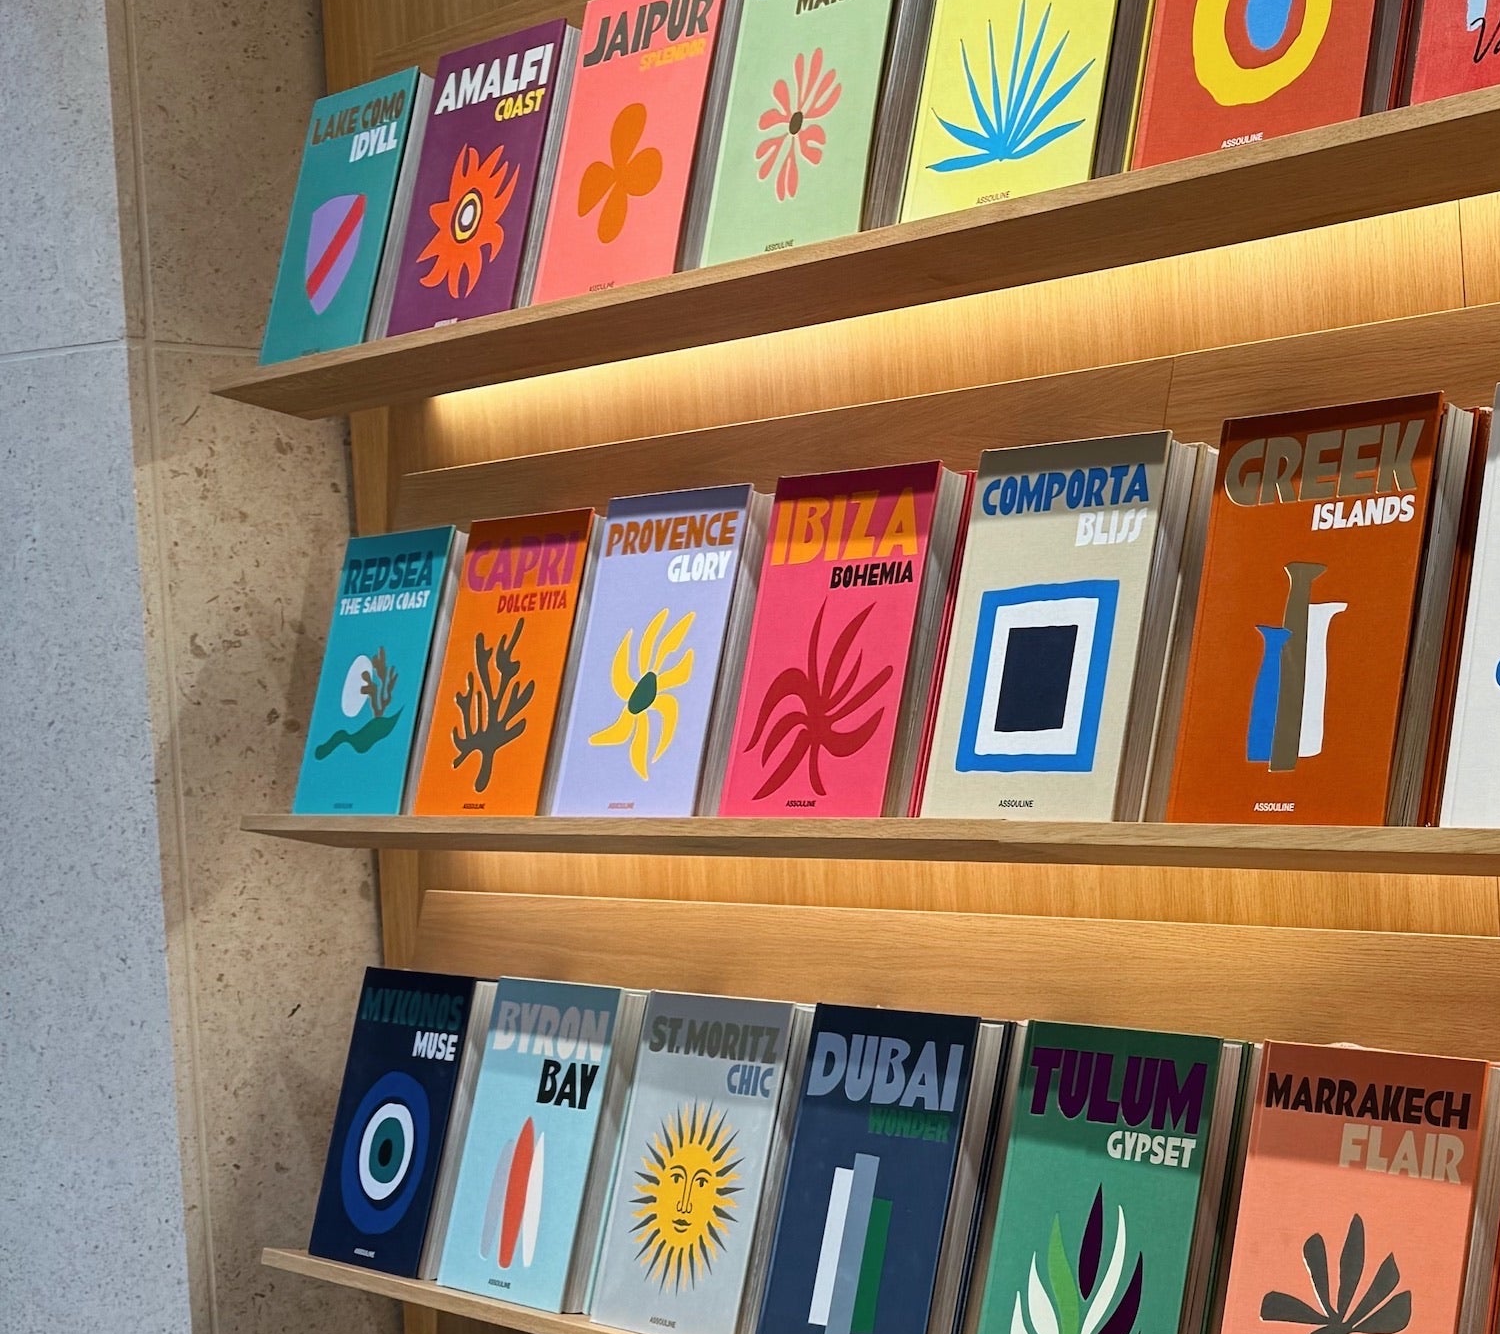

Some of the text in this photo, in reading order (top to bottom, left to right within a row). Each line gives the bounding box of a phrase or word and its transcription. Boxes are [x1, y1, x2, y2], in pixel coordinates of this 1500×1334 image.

[434, 43, 555, 115] AMALFI
[311, 90, 406, 145] LAKE COMO
[494, 88, 546, 122] COAST
[349, 122, 398, 163] IDYLL
[1221, 132, 1263, 149] ASSOULINE
[976, 190, 1011, 205] ASSOULINE
[1223, 419, 1426, 508] GREEK
[982, 463, 1150, 516] COMPORTA
[771, 486, 918, 567] IBIZA
[1074, 507, 1148, 547] BLISS
[1311, 494, 1416, 532] ISLANDS
[605, 511, 739, 559] PROVENCE
[467, 531, 581, 593] CAPRI
[667, 550, 732, 583] GLORY
[830, 561, 914, 589] BOHEMIA
[340, 590, 429, 616] THE SAUDI COAST
[497, 589, 568, 614] DOLCE VITA
[785, 799, 817, 809] ASSOULINE
[998, 799, 1034, 809] ASSOULINE
[1253, 802, 1295, 813] ASSOULINE
[361, 987, 464, 1031] MYKONOS
[412, 1030, 458, 1061] MUSE
[492, 1000, 610, 1062] BYRON
[648, 1014, 780, 1064] ST. MORITZ
[536, 1059, 600, 1110] BAY
[726, 1065, 775, 1098] CHIC
[806, 1032, 965, 1112] DUBAI
[1030, 1047, 1208, 1135] TULUM
[1264, 1071, 1472, 1131] MARRAKECH
[1107, 1130, 1198, 1168] GYPSET
[1339, 1124, 1466, 1185] FLAIR
